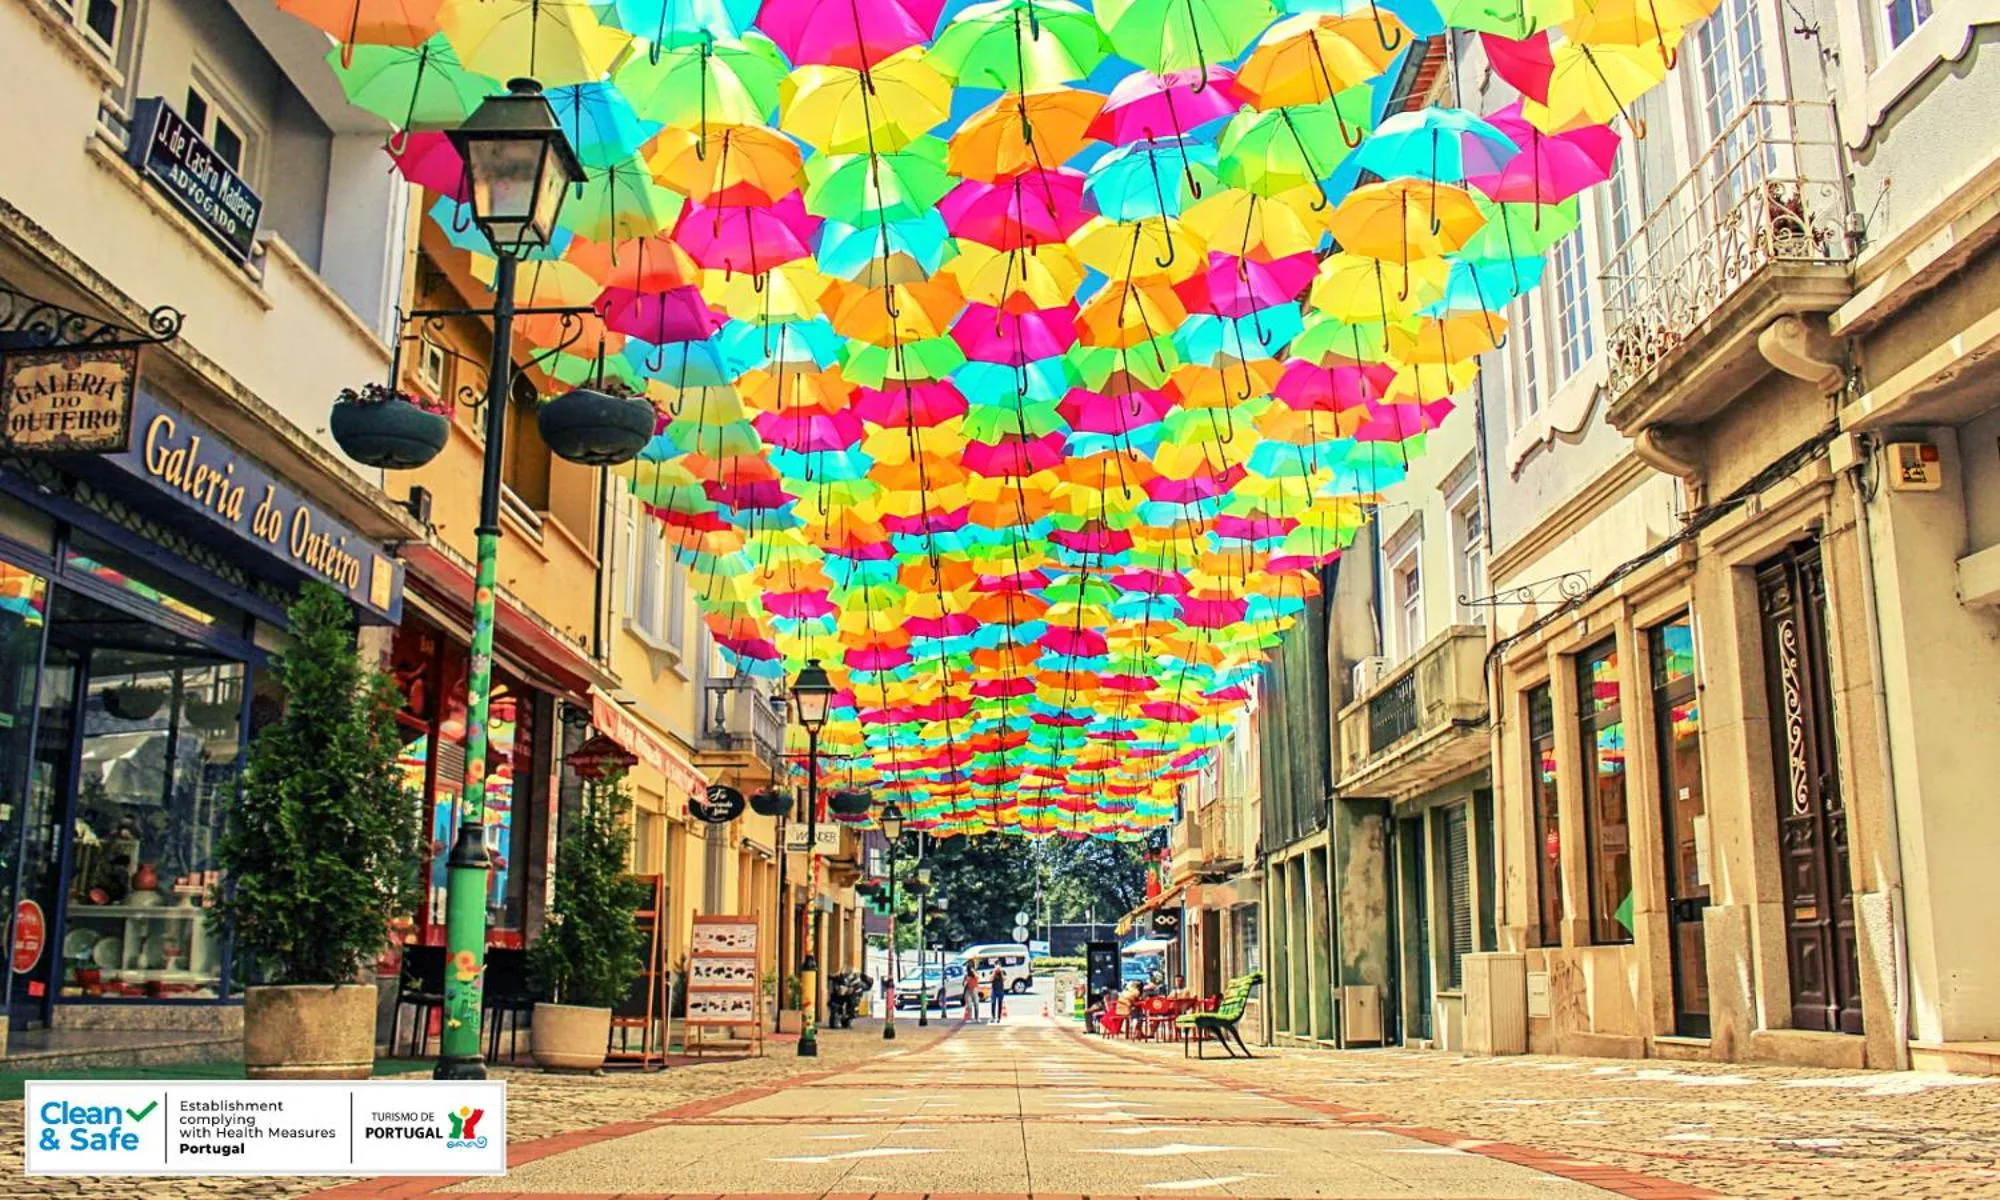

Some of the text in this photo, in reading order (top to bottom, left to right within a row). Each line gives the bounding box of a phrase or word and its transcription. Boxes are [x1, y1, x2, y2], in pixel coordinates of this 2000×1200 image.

[158, 112, 256, 229] J. de Castro Madeira
[168, 163, 236, 234] ADVOGADO
[15, 372, 118, 404] GALERIA
[52, 396, 81, 408] DO
[12, 409, 118, 432] OUTEIRO
[145, 414, 360, 590] Galeria do Outeiro
[795, 831, 836, 843] WNDER
